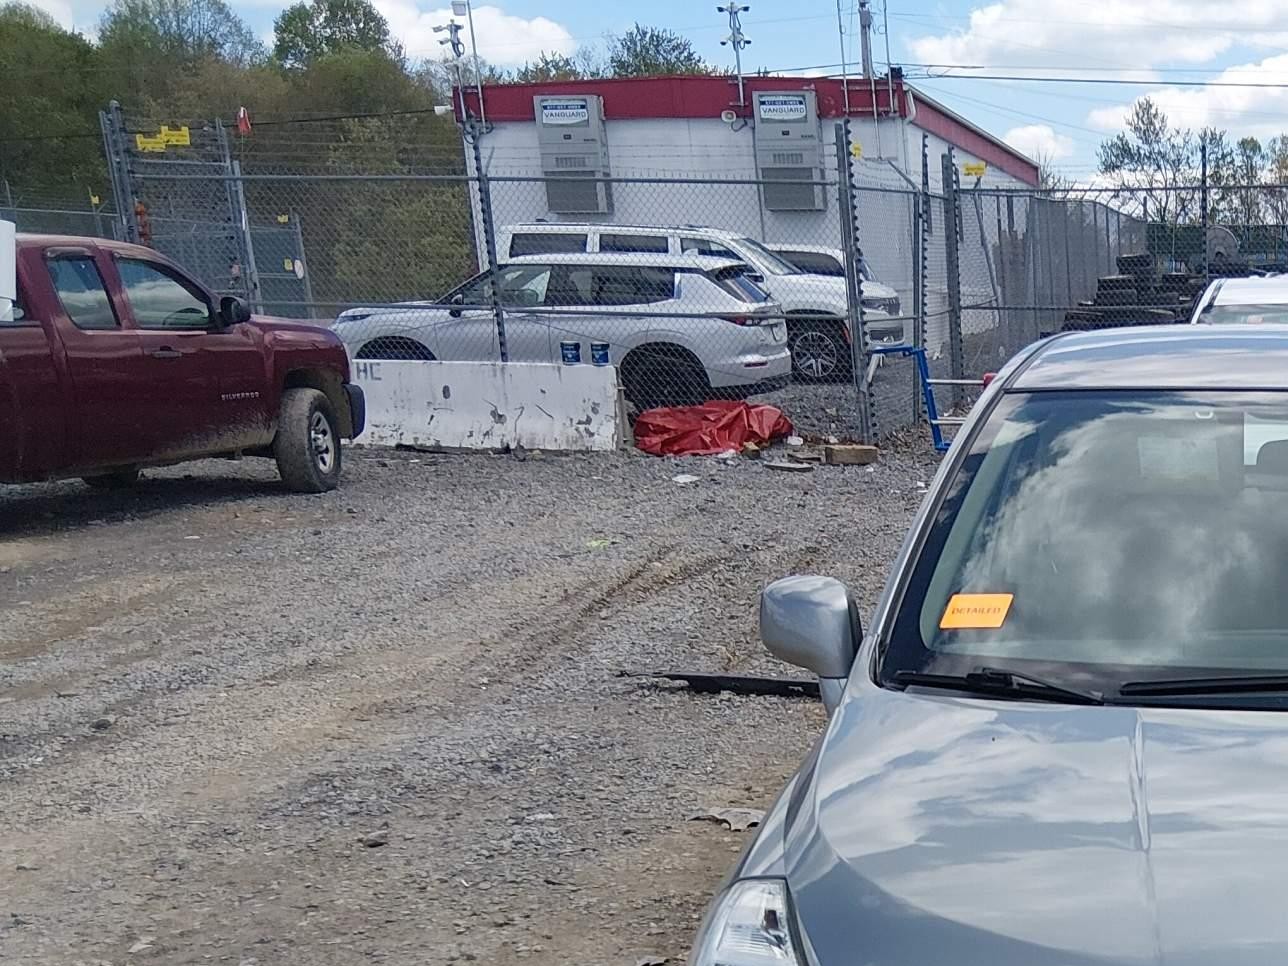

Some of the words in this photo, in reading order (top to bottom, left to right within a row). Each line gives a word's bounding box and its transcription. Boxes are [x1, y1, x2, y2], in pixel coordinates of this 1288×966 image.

[762, 106, 805, 114] VANGUARD
[544, 111, 587, 119] VANGUARD
[951, 607, 1002, 616] DETAILED
